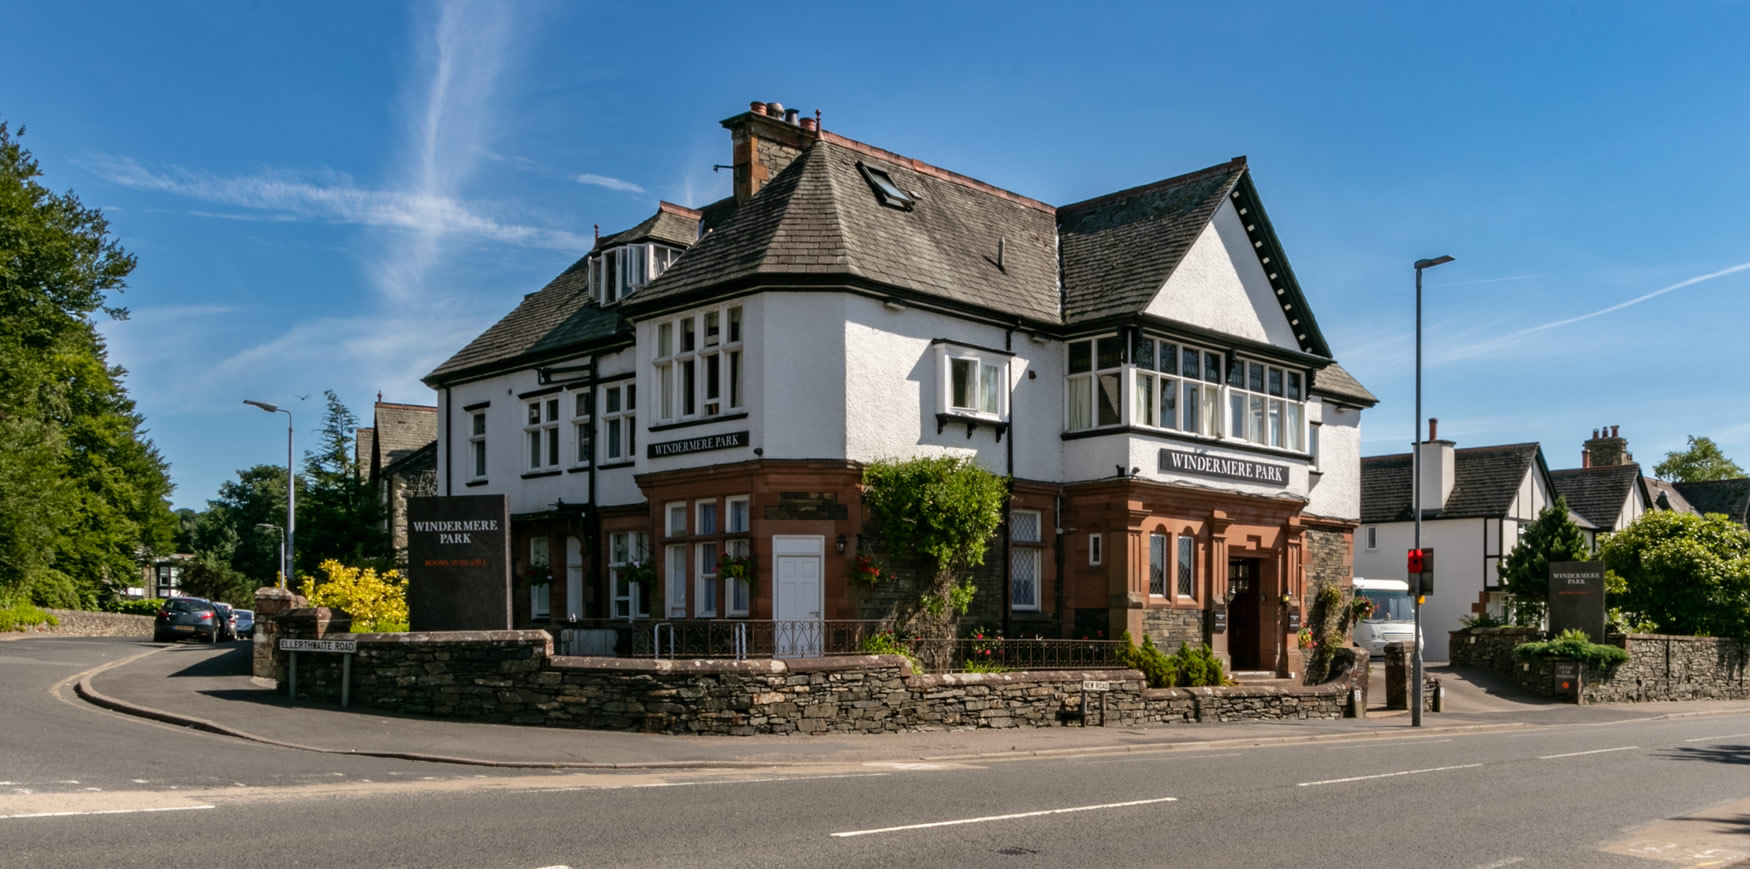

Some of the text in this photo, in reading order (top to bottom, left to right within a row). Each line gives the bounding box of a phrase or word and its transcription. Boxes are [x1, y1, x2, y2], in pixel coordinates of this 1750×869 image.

[654, 434, 738, 454] WINDERMERE PARK
[1171, 452, 1282, 481] WINDERMERE PARK
[413, 520, 498, 532] WINDERMERE
[440, 533, 471, 544] PARK
[281, 640, 354, 650] ELLERTHWAITE ROAD
